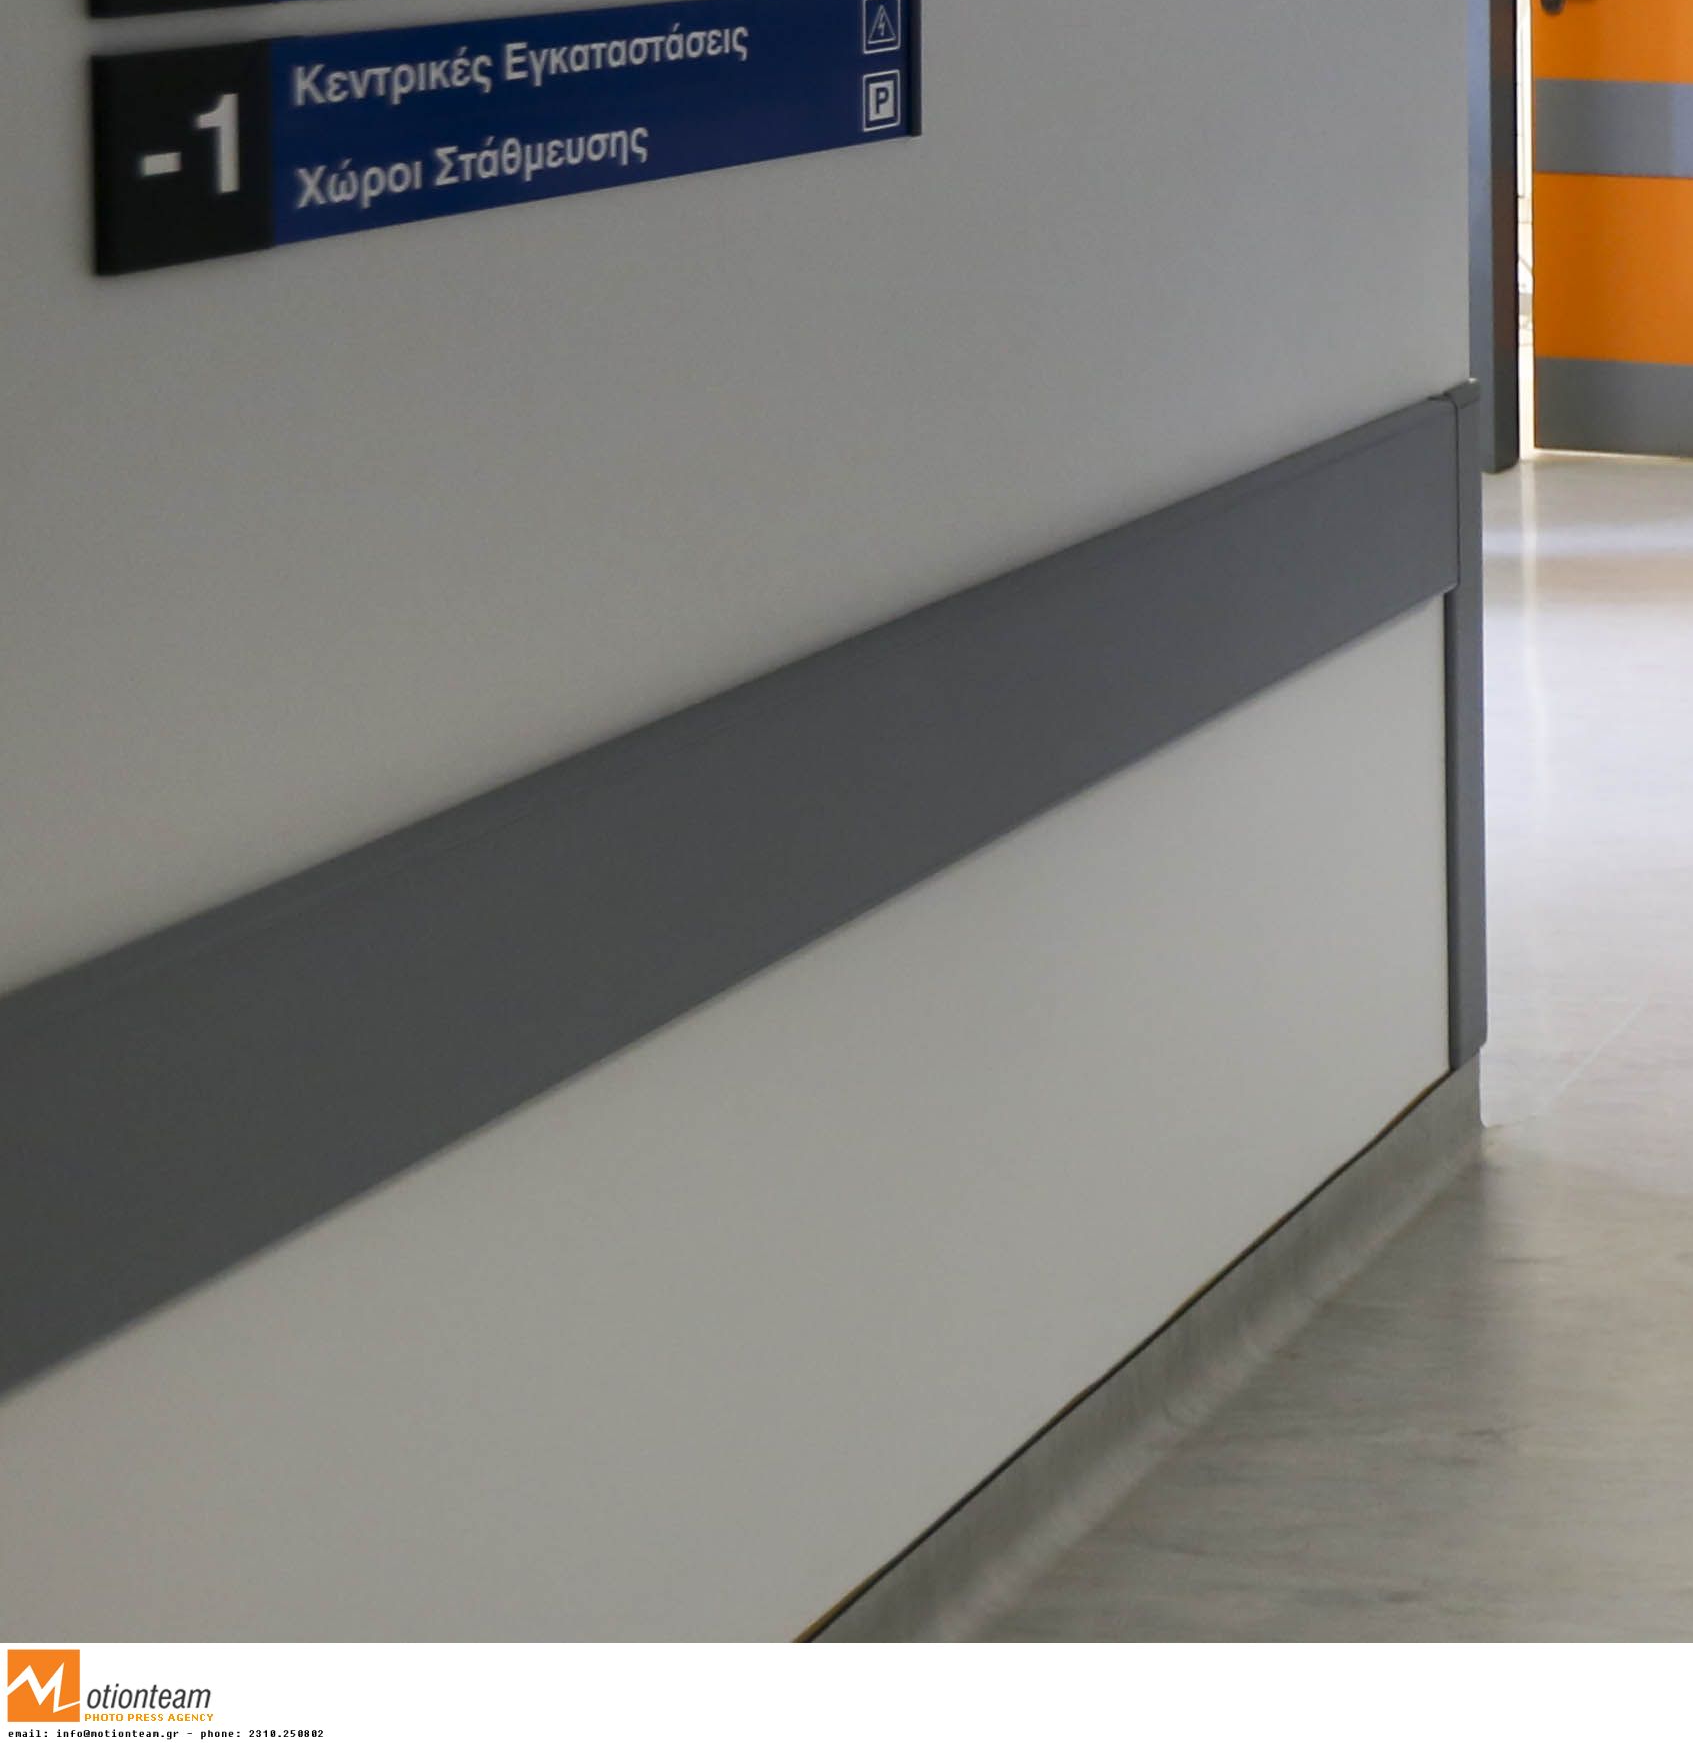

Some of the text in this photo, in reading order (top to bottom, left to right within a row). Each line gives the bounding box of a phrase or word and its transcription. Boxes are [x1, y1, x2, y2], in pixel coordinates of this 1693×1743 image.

[292, 22, 749, 106] Κεντρικές Εγκαταστάσεις
[142, 93, 240, 194] -1
[296, 126, 649, 209] Χώροι Στάθμευσης
